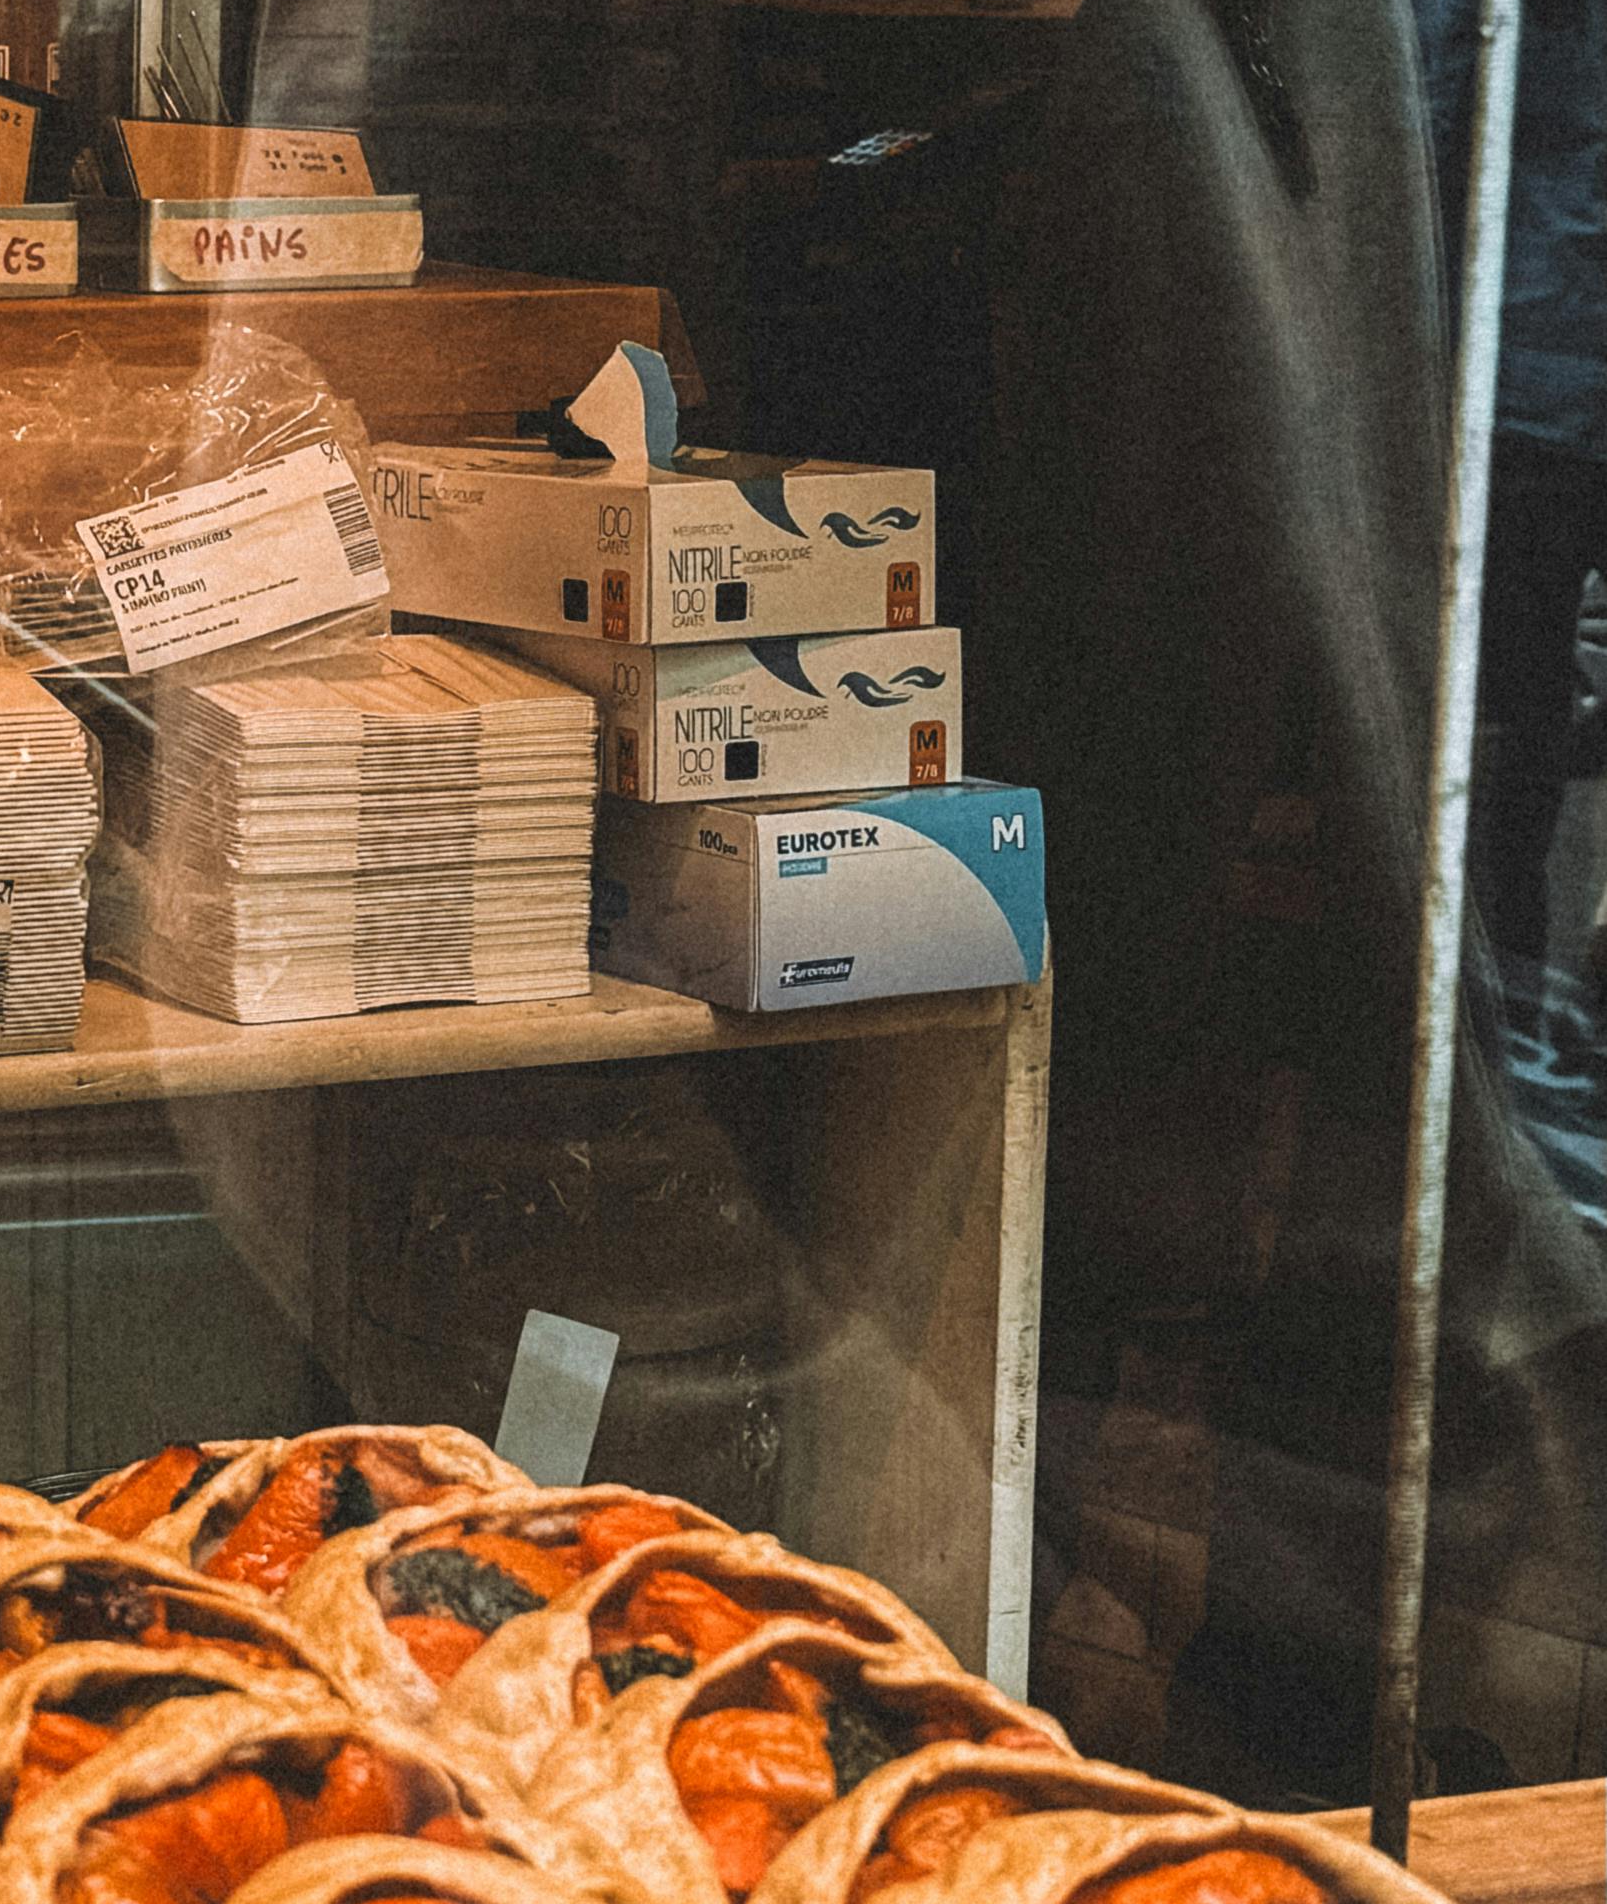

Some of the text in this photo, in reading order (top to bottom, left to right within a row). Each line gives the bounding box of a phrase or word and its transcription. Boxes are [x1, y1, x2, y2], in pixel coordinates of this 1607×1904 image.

[597, 504, 632, 539] 100
[668, 545, 742, 584] NITRILE
[114, 568, 166, 601] CP14
[606, 576, 623, 603] M
[893, 569, 914, 593] M
[672, 588, 706, 615] 100
[892, 606, 915, 622] 7/8
[675, 705, 754, 744] NITRILE
[916, 728, 939, 753] M
[677, 747, 715, 774] 100
[915, 763, 939, 779] 7/8
[677, 773, 715, 787] GANTS
[776, 826, 880, 856] EUROTEX
[991, 812, 1026, 853] M
